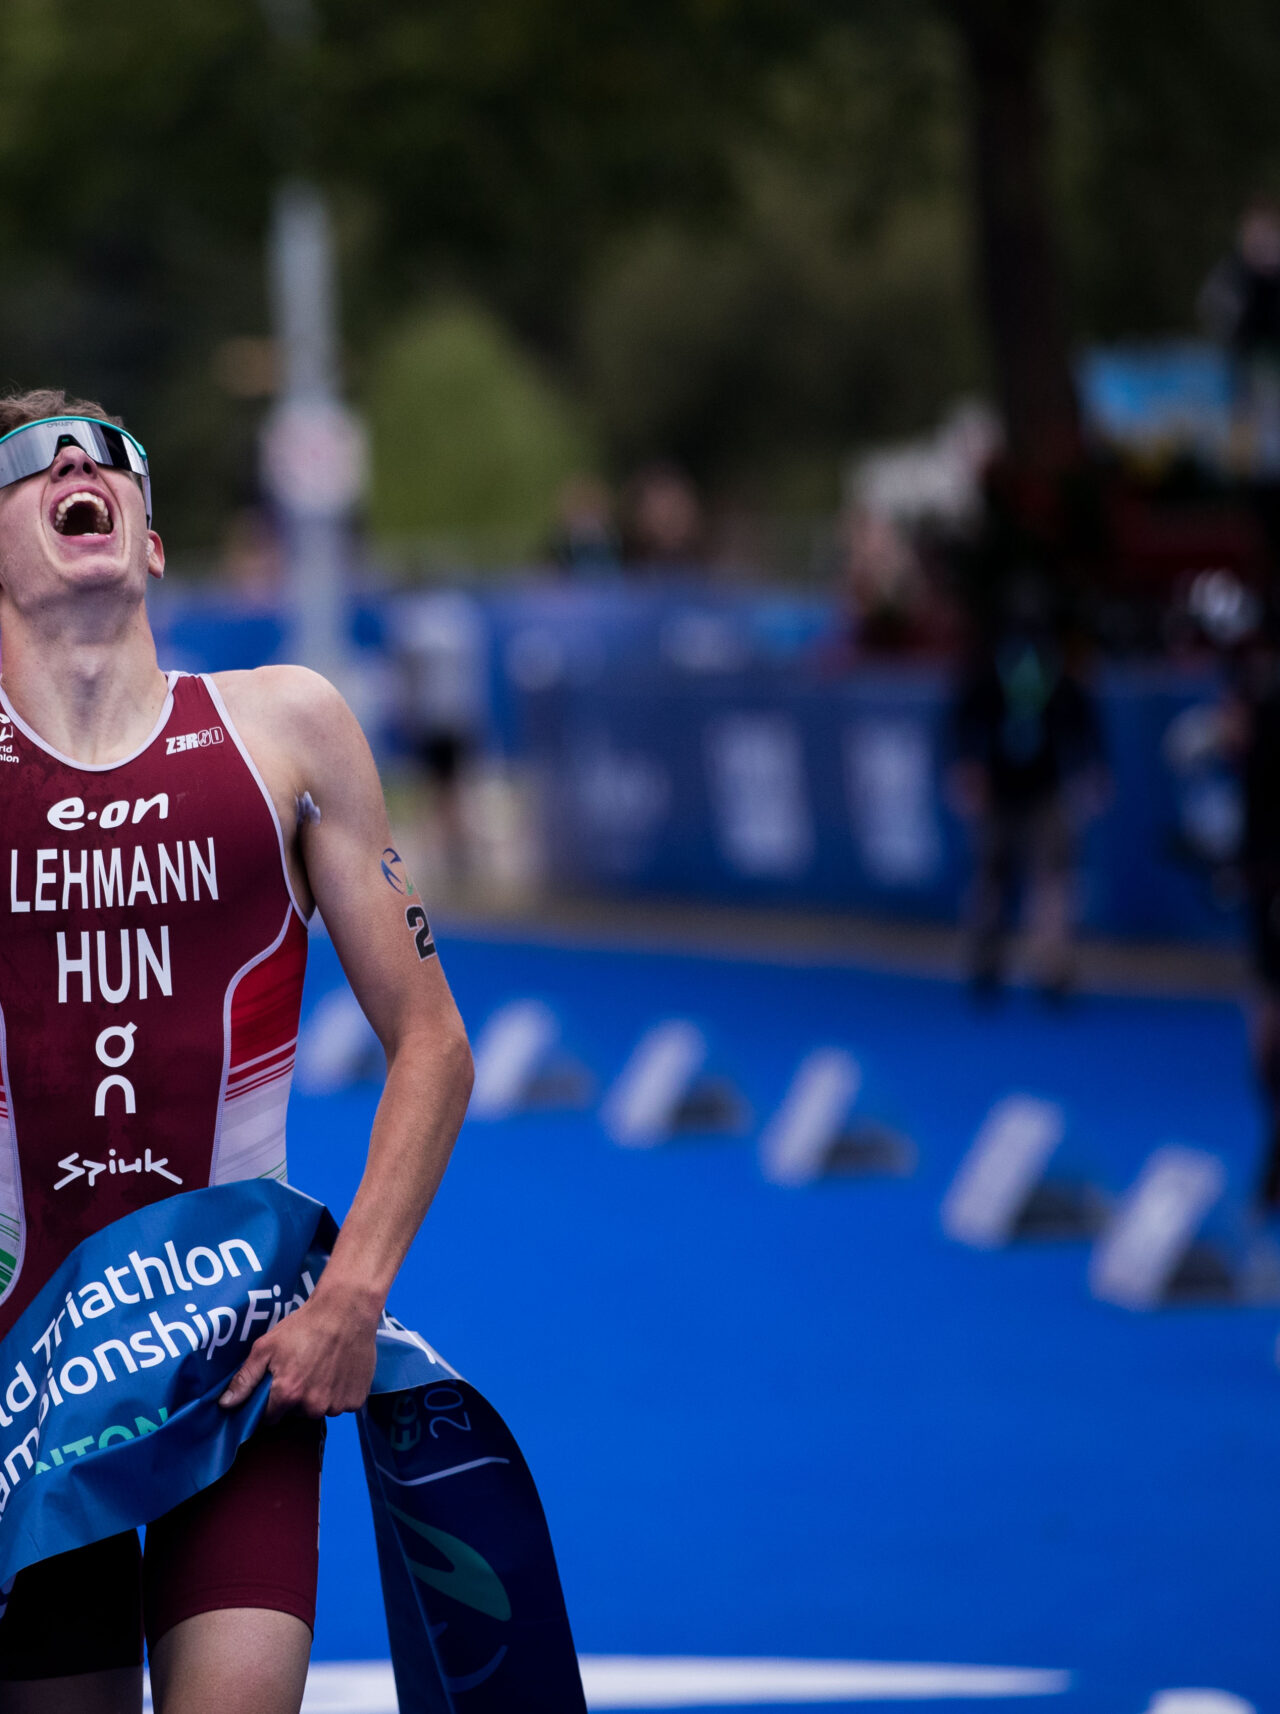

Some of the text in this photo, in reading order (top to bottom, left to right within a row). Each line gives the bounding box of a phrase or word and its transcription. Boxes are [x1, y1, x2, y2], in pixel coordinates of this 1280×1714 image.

[10, 836, 219, 913] LEHMANN
[56, 925, 173, 1004] HUN
[405, 904, 437, 962] 2
[32, 1238, 263, 1365] Triathlon
